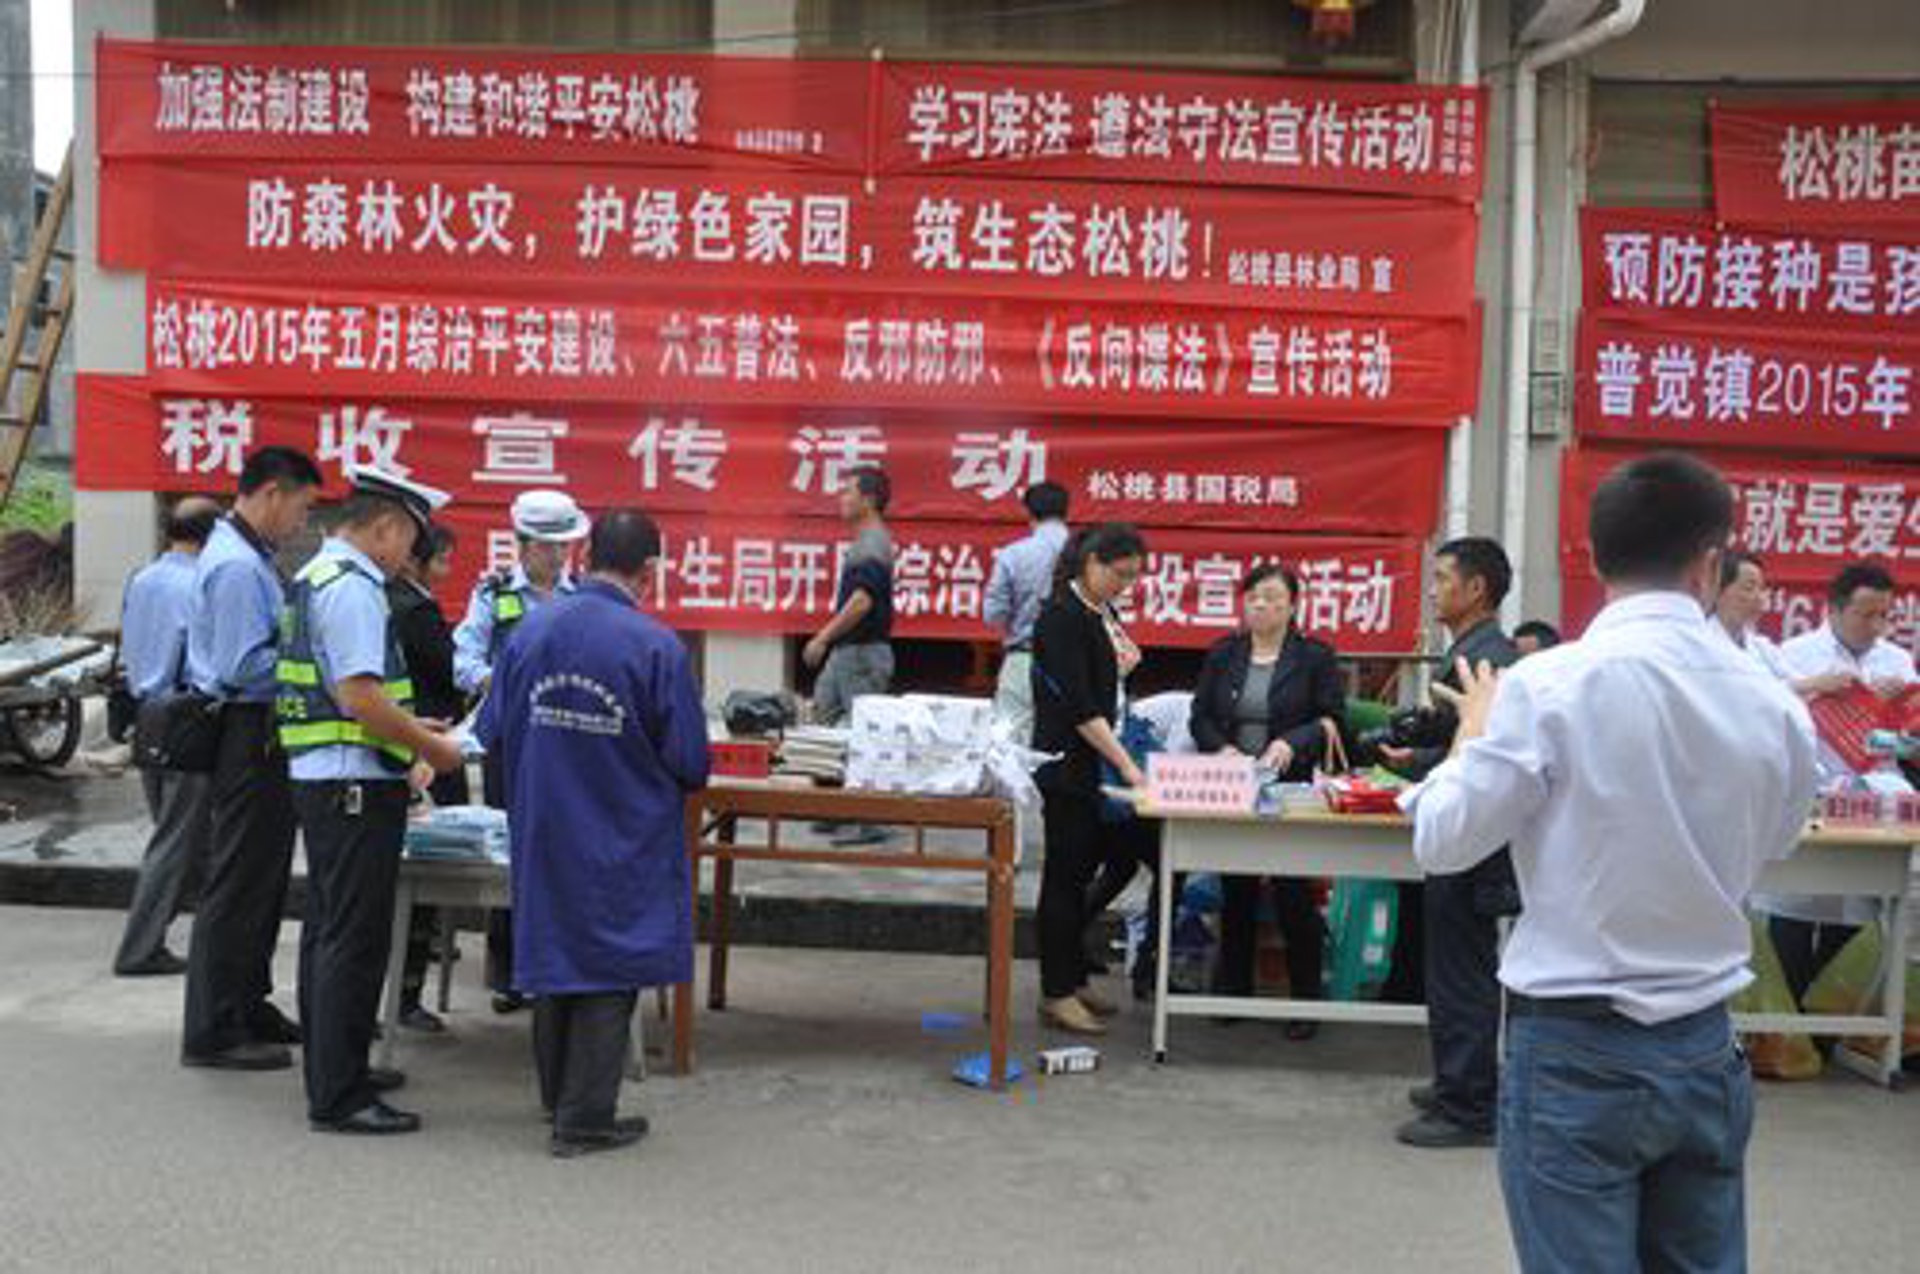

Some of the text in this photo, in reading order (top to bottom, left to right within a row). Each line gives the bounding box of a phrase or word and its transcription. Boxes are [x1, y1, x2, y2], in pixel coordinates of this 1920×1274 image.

[155, 61, 700, 143] 加强法制建设 构建和谐平安松桃
[908, 84, 1072, 162] 学习宪法
[1086, 92, 1433, 174] 遵法守法宣传活动
[1596, 342, 1912, 430] 普觉镇2015年
[1087, 470, 1299, 506] 松桃县国税局
